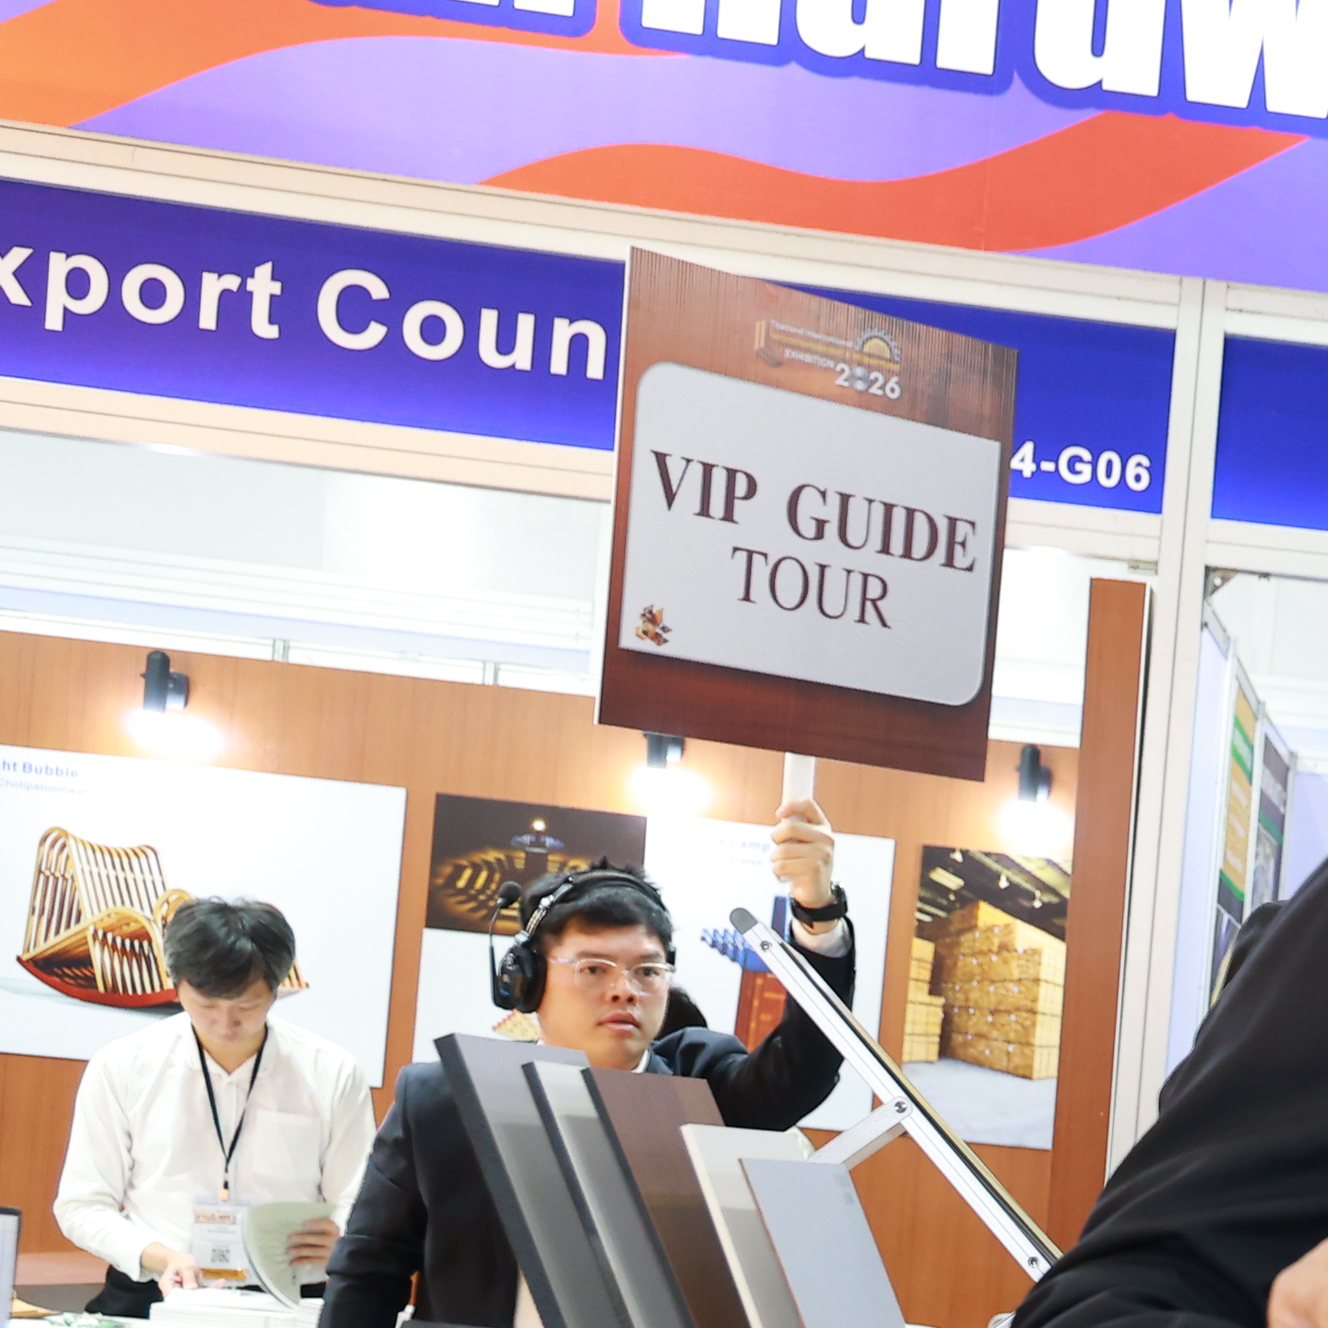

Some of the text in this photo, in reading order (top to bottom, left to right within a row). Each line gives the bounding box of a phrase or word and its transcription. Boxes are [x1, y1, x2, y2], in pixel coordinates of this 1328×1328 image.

[0, 246, 607, 380] xport Coun
[1010, 440, 1151, 492] 4-G06
[650, 449, 977, 572] VIP GUIDE
[731, 546, 892, 629] TOUR
[22, 761, 78, 778] Bubble
